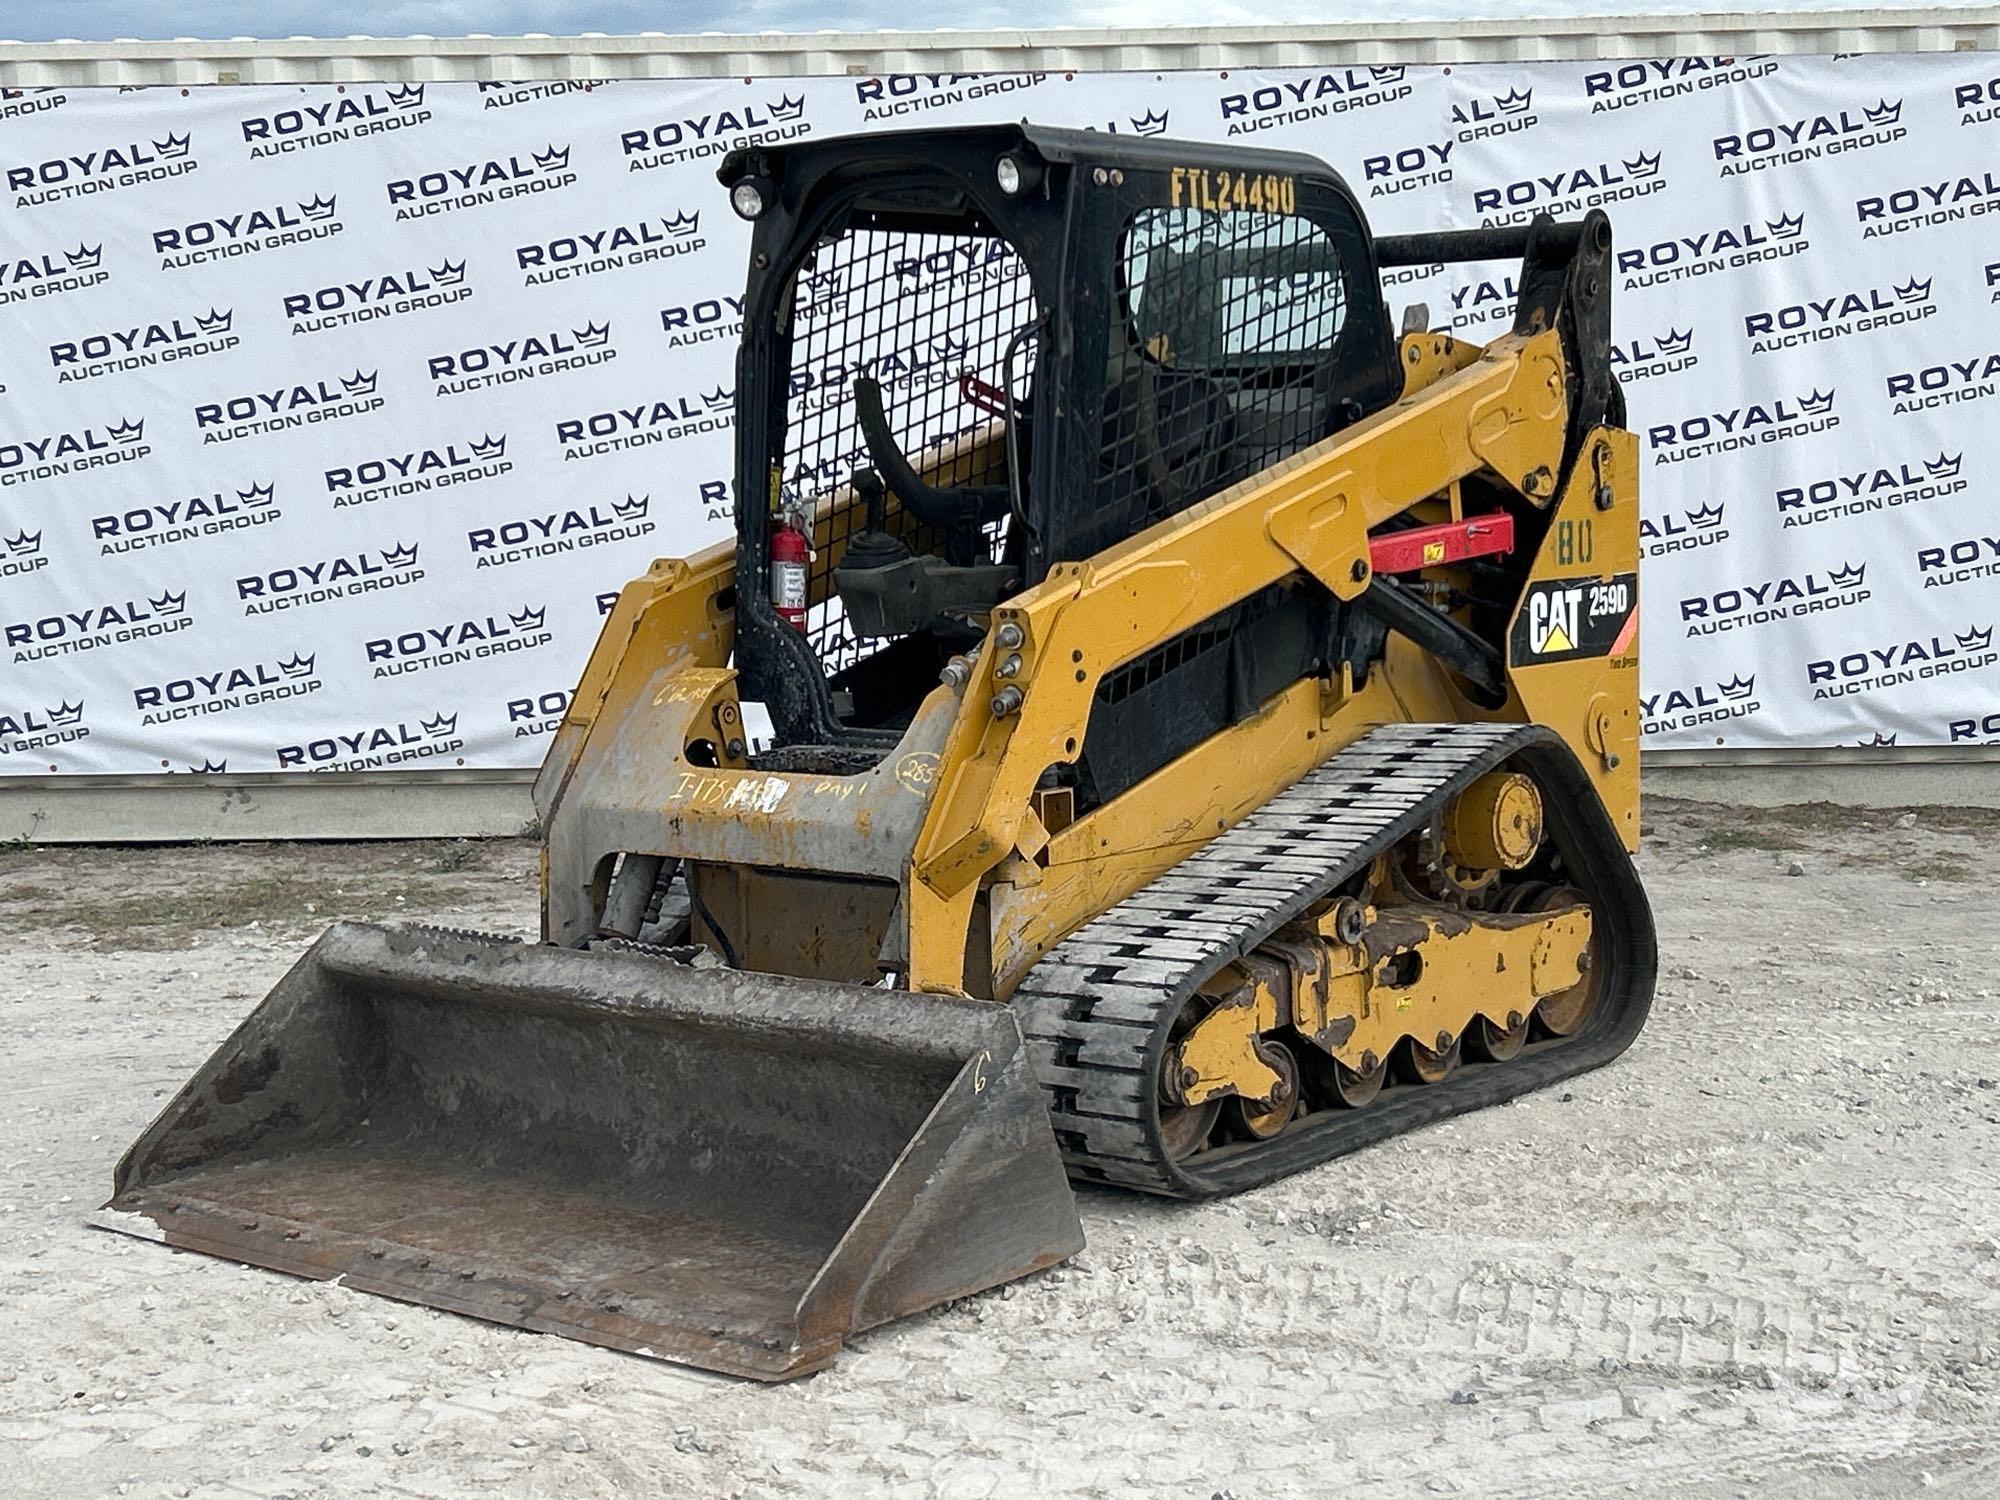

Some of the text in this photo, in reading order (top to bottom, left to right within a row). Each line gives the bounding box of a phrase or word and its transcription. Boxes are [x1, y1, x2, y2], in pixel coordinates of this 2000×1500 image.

[864, 72, 1046, 122] AUCTION GROUP
[1220, 70, 1369, 119] ROYAL
[1228, 86, 1412, 136] AUCTION GROUP
[1592, 62, 1778, 113] AUCTION GROUP
[241, 95, 389, 143] ROYAL
[251, 110, 432, 159] AUCTION GROUP
[621, 107, 769, 155] ROYAL
[1458, 116, 1537, 143] GROUP
[1713, 112, 1864, 161] ROYAL
[7, 144, 155, 192] ROYAL
[630, 123, 811, 172] AUCTION GROUP
[1364, 141, 1455, 180] ROY
[1720, 127, 1907, 178] AUCTION GROUP
[16, 160, 197, 209] AUCTION GROUP
[387, 157, 534, 205] ROYAL
[396, 173, 576, 222] AUCTION GROUP
[1171, 167, 1294, 215] FTL24490
[1371, 170, 1453, 197] AUCTIO
[1474, 164, 1623, 213] ROYAL
[1482, 180, 1666, 230] AUCTION GROUP
[1856, 173, 2000, 222] ROYAL
[153, 206, 300, 254] ROYAL
[162, 222, 343, 271] AUCTION GROUP
[516, 222, 664, 270] ROYAL
[1863, 207, 1965, 240] AUCTION
[525, 238, 706, 287] AUCTION GROUP
[1618, 225, 1767, 274] ROYAL
[1625, 240, 1809, 291] AUCTION GROUP
[31, 271, 109, 297] GROUP
[283, 271, 430, 319] ROYAL
[1382, 264, 1445, 287] ROUP
[293, 287, 473, 335] AUCTION GROUP
[1745, 289, 1894, 338] ROYAL
[1752, 305, 1936, 355] AUCTION GROUP
[49, 320, 197, 367] ROYAL
[59, 336, 239, 384] AUCTION GROUP
[428, 333, 574, 380] ROYAL
[437, 349, 616, 397] AUCTION GROUP
[1619, 356, 1698, 383] GROUP
[195, 381, 342, 428] ROYAL
[204, 397, 384, 445] AUCTION GROUP
[556, 398, 703, 445] ROYAL
[1894, 384, 1995, 415] AUCTION
[0, 430, 108, 468] OYAL
[565, 431, 663, 461] AUCTION
[1649, 401, 1798, 449] ROYAL
[1656, 416, 1840, 466] AUCTION GROUP
[1, 445, 151, 486] CTION GROUP
[325, 446, 471, 492] ROYAL
[334, 462, 513, 509] AUCTION GROUP
[1776, 464, 1924, 512] ROYAL
[92, 494, 239, 540] ROYAL
[1783, 480, 1967, 529] AUCTION GROUP
[101, 509, 281, 556] AUCTION GROUP
[468, 506, 613, 553] ROYAL
[477, 522, 655, 569] AUCTION GROUP
[1650, 530, 1729, 556] GROUP
[236, 554, 383, 600] ROYAL
[246, 570, 425, 617] AUCTION GROUP
[1680, 574, 1829, 621] ROYAL
[5, 602, 151, 647] ROYAL
[1529, 583, 1628, 655] CAT 259D
[1687, 590, 1871, 638] AUCTION GROUP
[14, 617, 193, 664] AUCTION GROUP
[365, 617, 510, 663] ROYAL
[374, 633, 552, 679] AUCTION GROUP
[1807, 637, 1955, 684] ROYAL
[134, 664, 280, 710] ROYAL
[1815, 653, 1998, 701] AUCTION GROUP
[143, 680, 322, 726] AUCTION GROUP
[1682, 701, 1760, 727] GROUP
[13, 727, 90, 752] GROUP
[277, 724, 422, 769] ROYAL
[387, 739, 463, 764] GROUP
